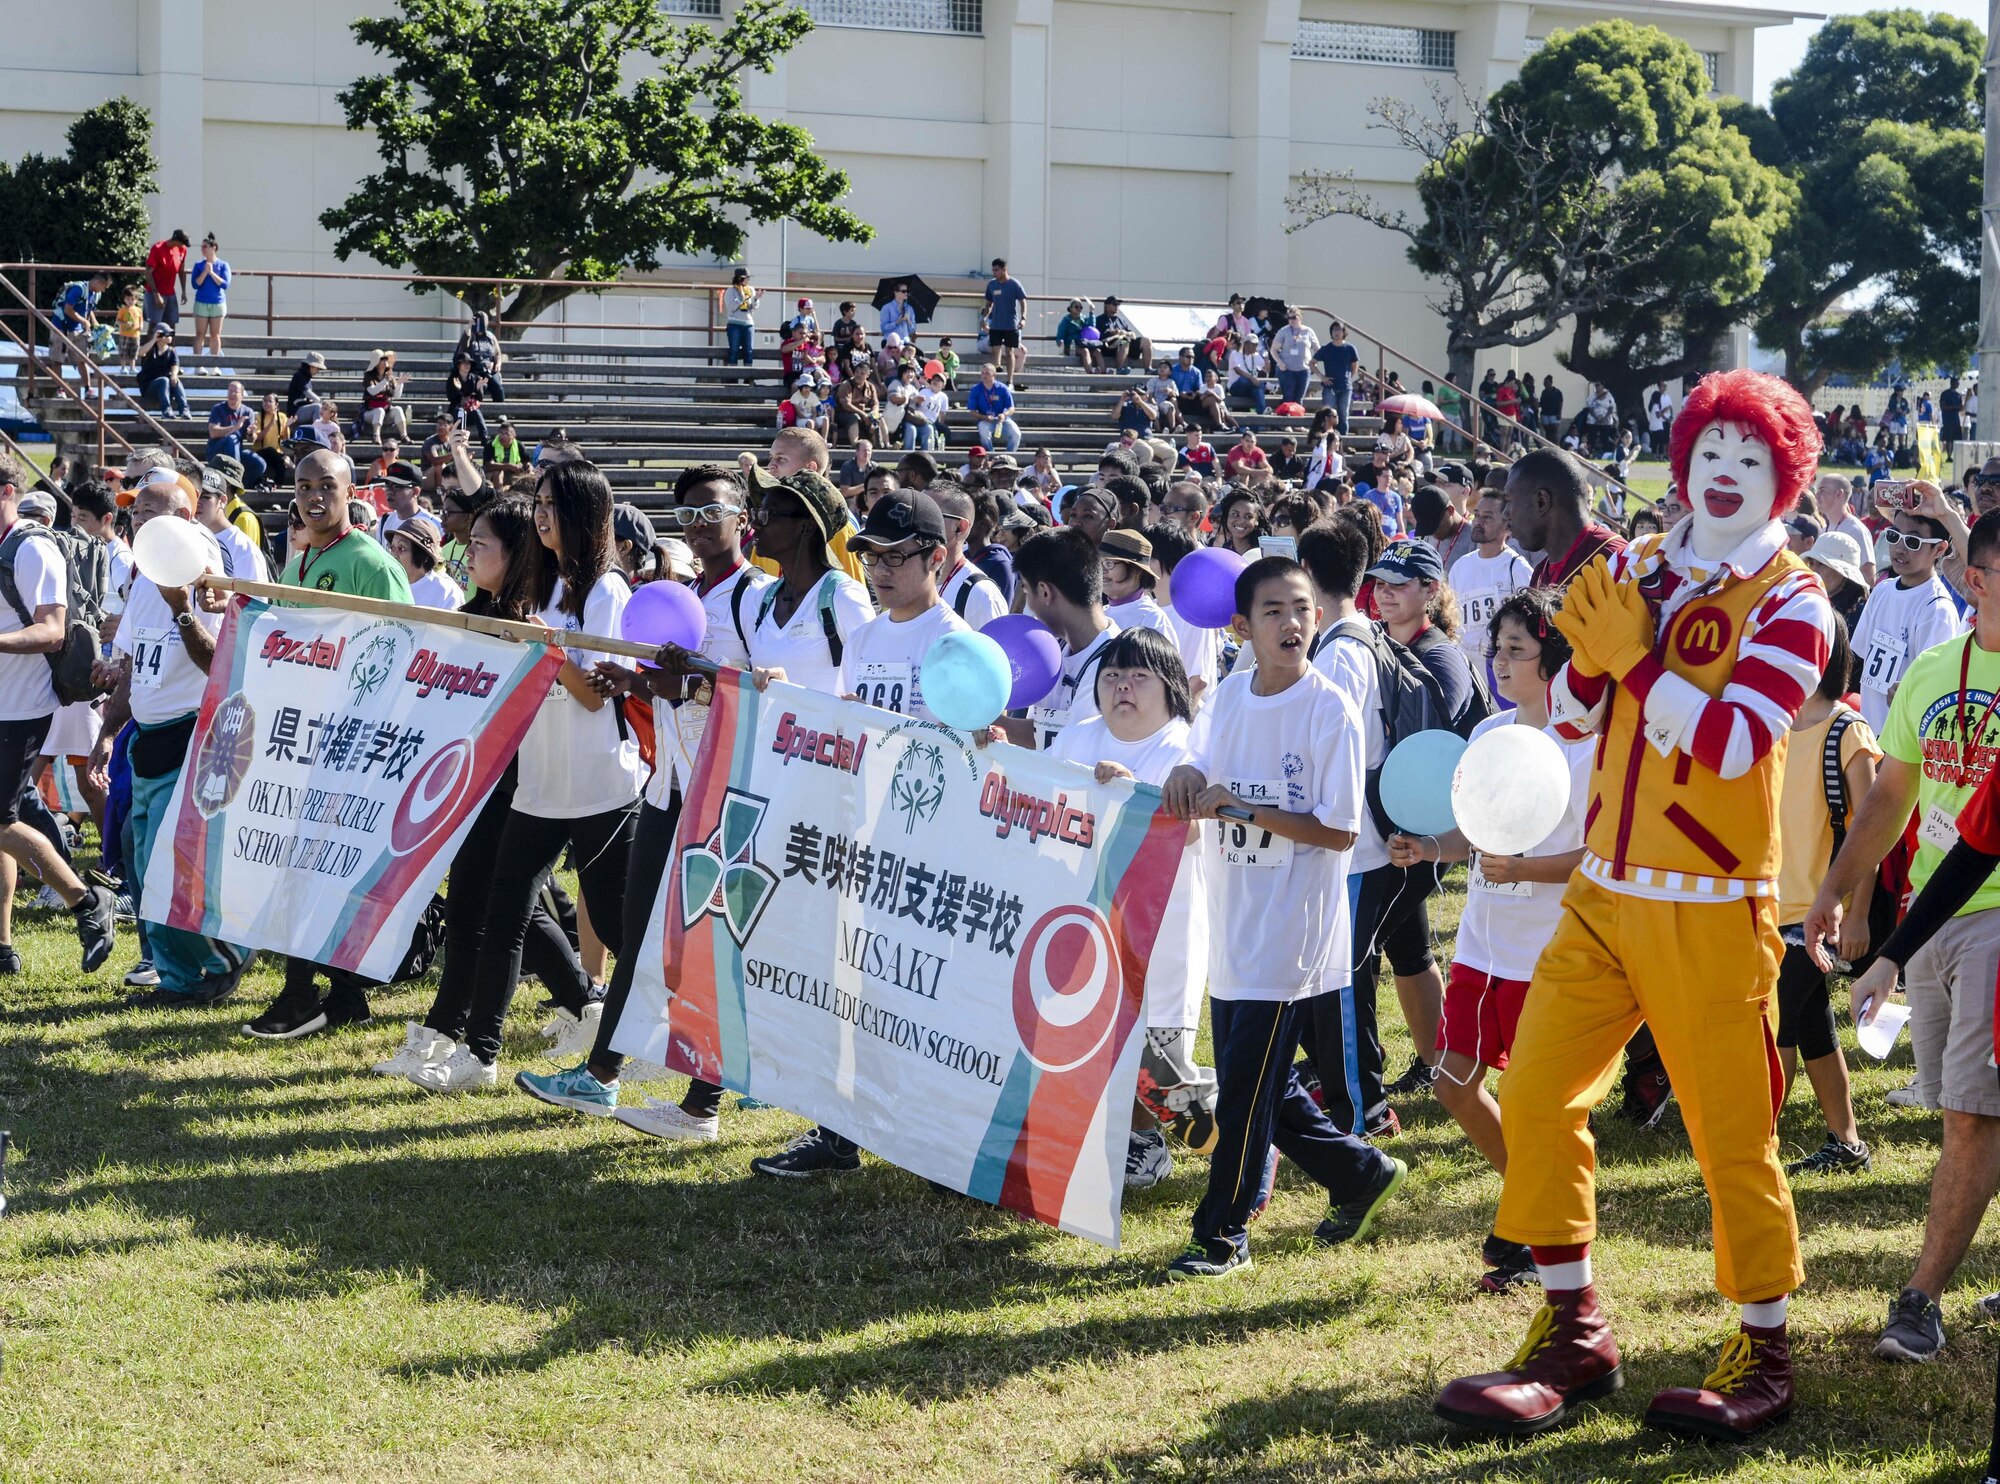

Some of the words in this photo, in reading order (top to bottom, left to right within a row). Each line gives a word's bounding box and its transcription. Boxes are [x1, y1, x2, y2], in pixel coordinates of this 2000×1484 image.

[405, 648, 500, 700] Olympics
[771, 711, 868, 776] Special
[1920, 696, 1951, 731] UNLEASH
[1954, 691, 1973, 702] TE
[903, 719, 918, 729] Air
[918, 720, 938, 730] Base
[939, 726, 965, 749] Okinawa
[965, 749, 979, 782] Japan
[980, 771, 1096, 850] Olympics
[783, 821, 1024, 959] 美咲特別支援学校
[839, 920, 948, 1001] MISAKI
[744, 958, 831, 1011] SPECIAL
[832, 986, 926, 1054] EDUCATION
[923, 1029, 1004, 1087] SCHOOL
